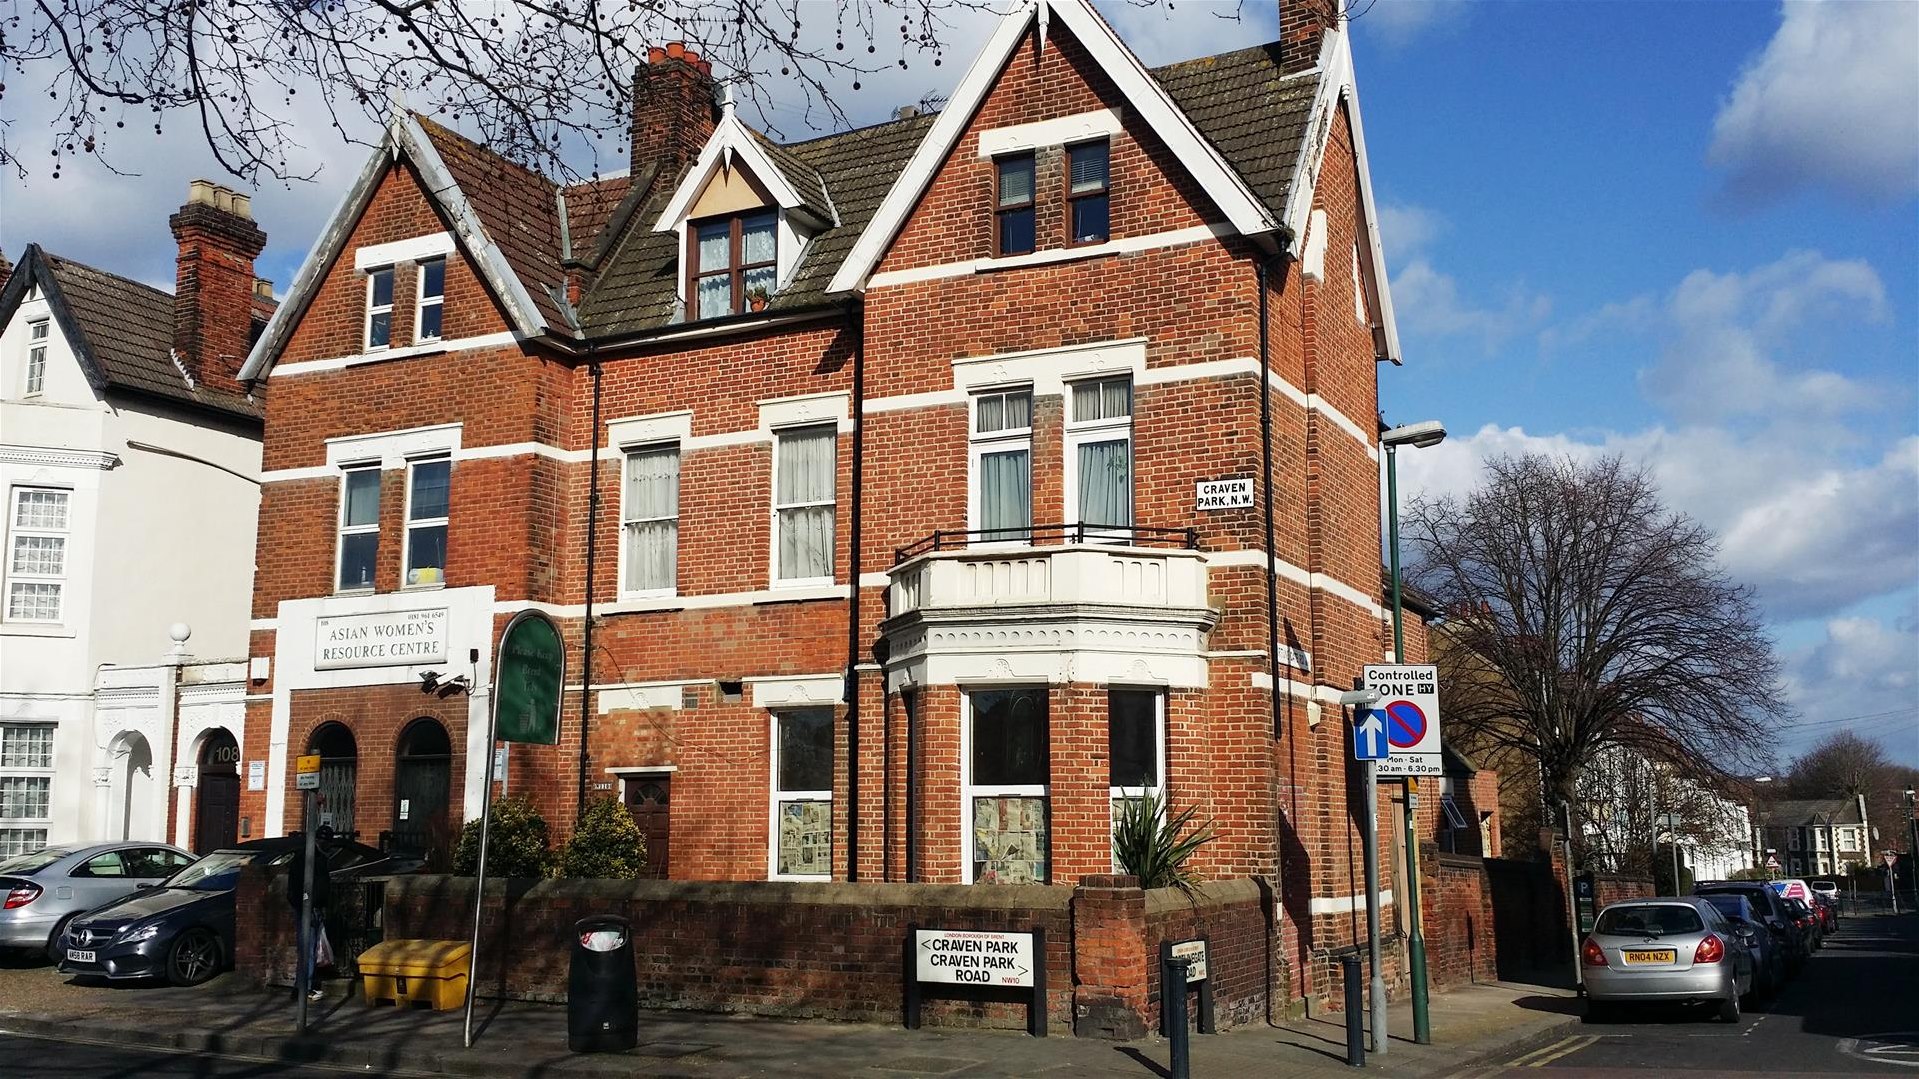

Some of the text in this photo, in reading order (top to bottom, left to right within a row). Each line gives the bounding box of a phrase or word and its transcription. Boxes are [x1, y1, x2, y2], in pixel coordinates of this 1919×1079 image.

[1203, 483, 1246, 494] CRAVEN
[329, 620, 435, 641] ASIAN WOMEN'S
[323, 641, 439, 660] RESOURCE CENTRE
[1368, 670, 1433, 680] Controlled
[1418, 684, 1433, 693] HY
[216, 746, 239, 762] 108
[932, 939, 1018, 954] CRAVEN PARK
[930, 954, 1015, 969] CRAVEN PARK
[1629, 952, 1670, 961] RN04 NZX
[955, 969, 991, 982] ROAD
